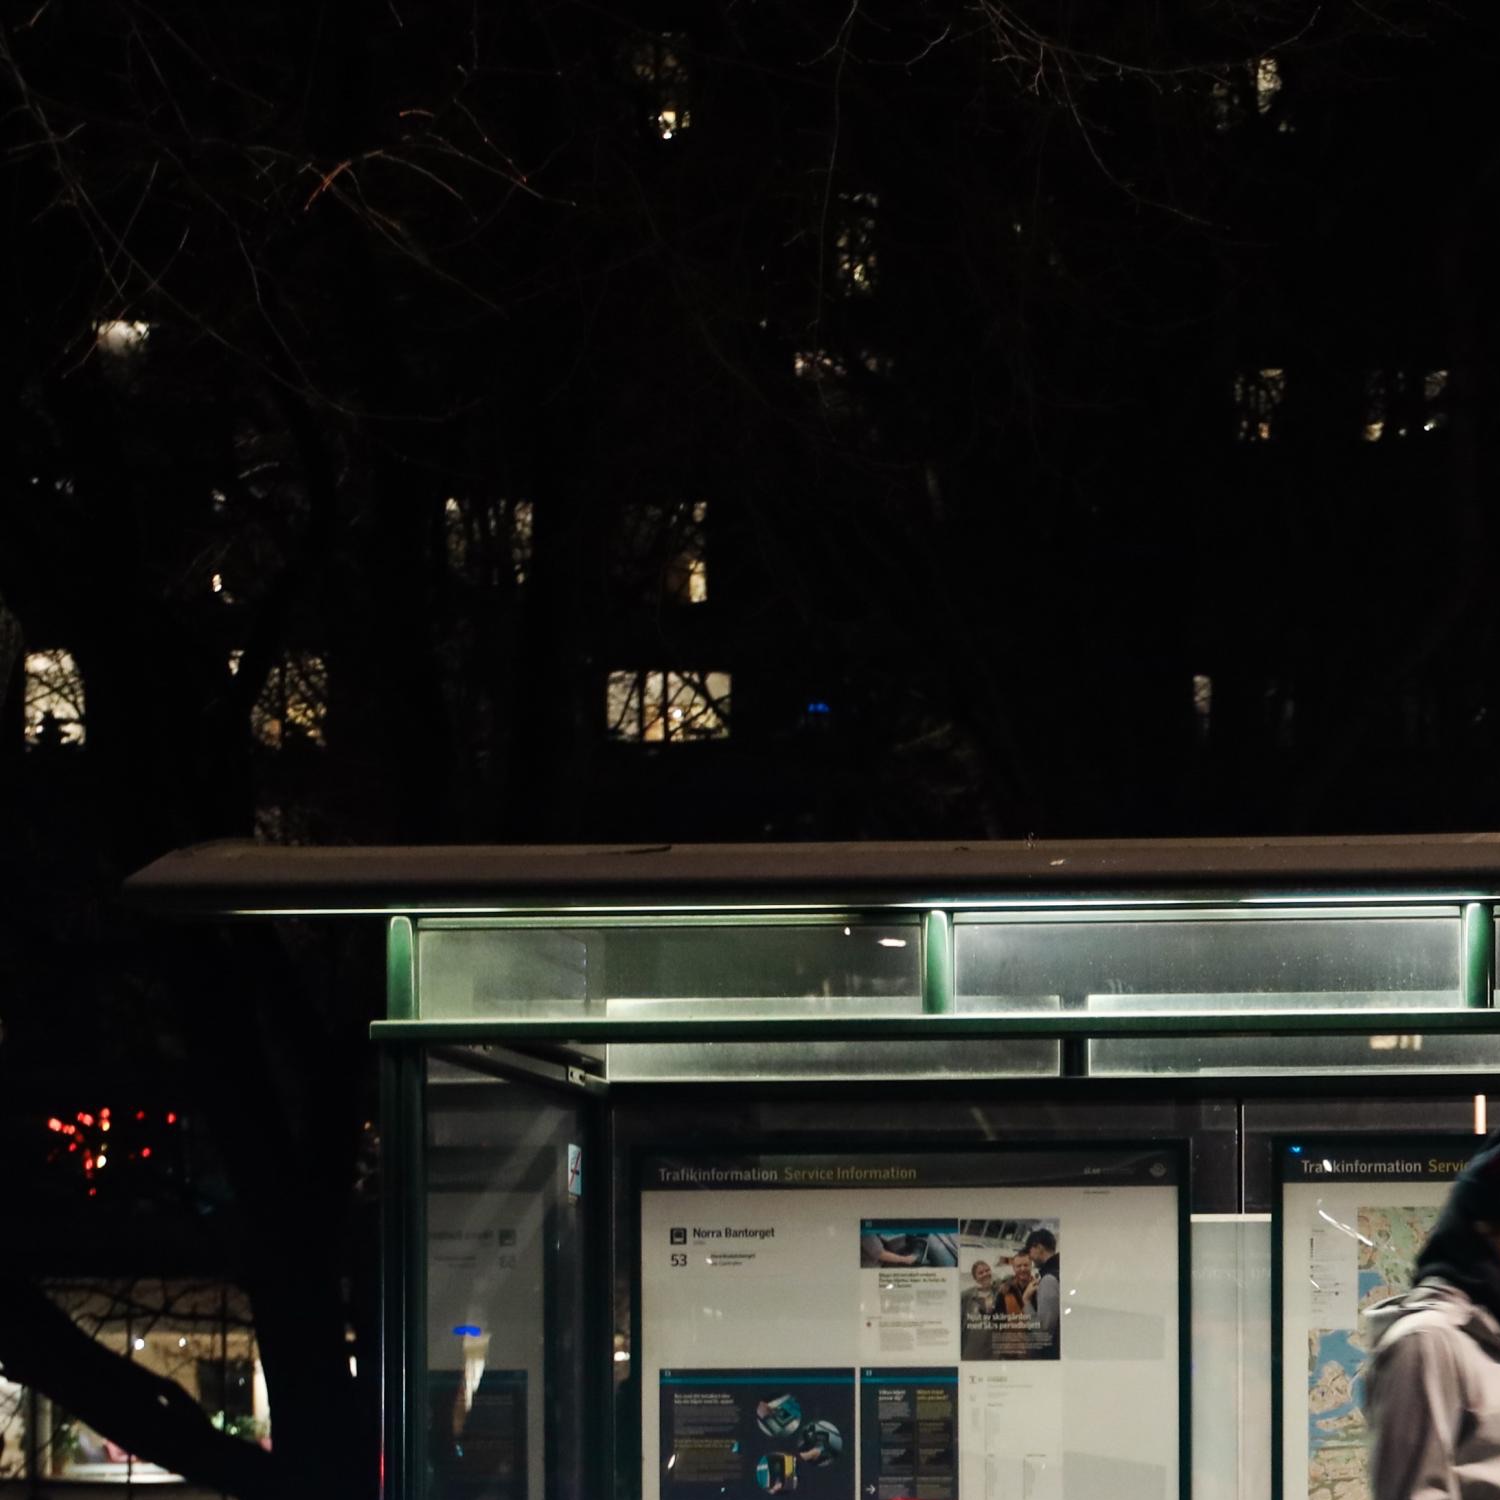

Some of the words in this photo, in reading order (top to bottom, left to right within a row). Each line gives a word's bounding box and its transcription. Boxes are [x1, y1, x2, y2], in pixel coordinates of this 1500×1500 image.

[659, 1167, 778, 1182] Trafikinformation
[784, 1166, 834, 1181] Service
[837, 1165, 917, 1180] Information
[1302, 1160, 1422, 1173] Trakinformation
[692, 1227, 722, 1239] Norra
[724, 1226, 775, 1240] Bantorget
[671, 1253, 687, 1267] 53
